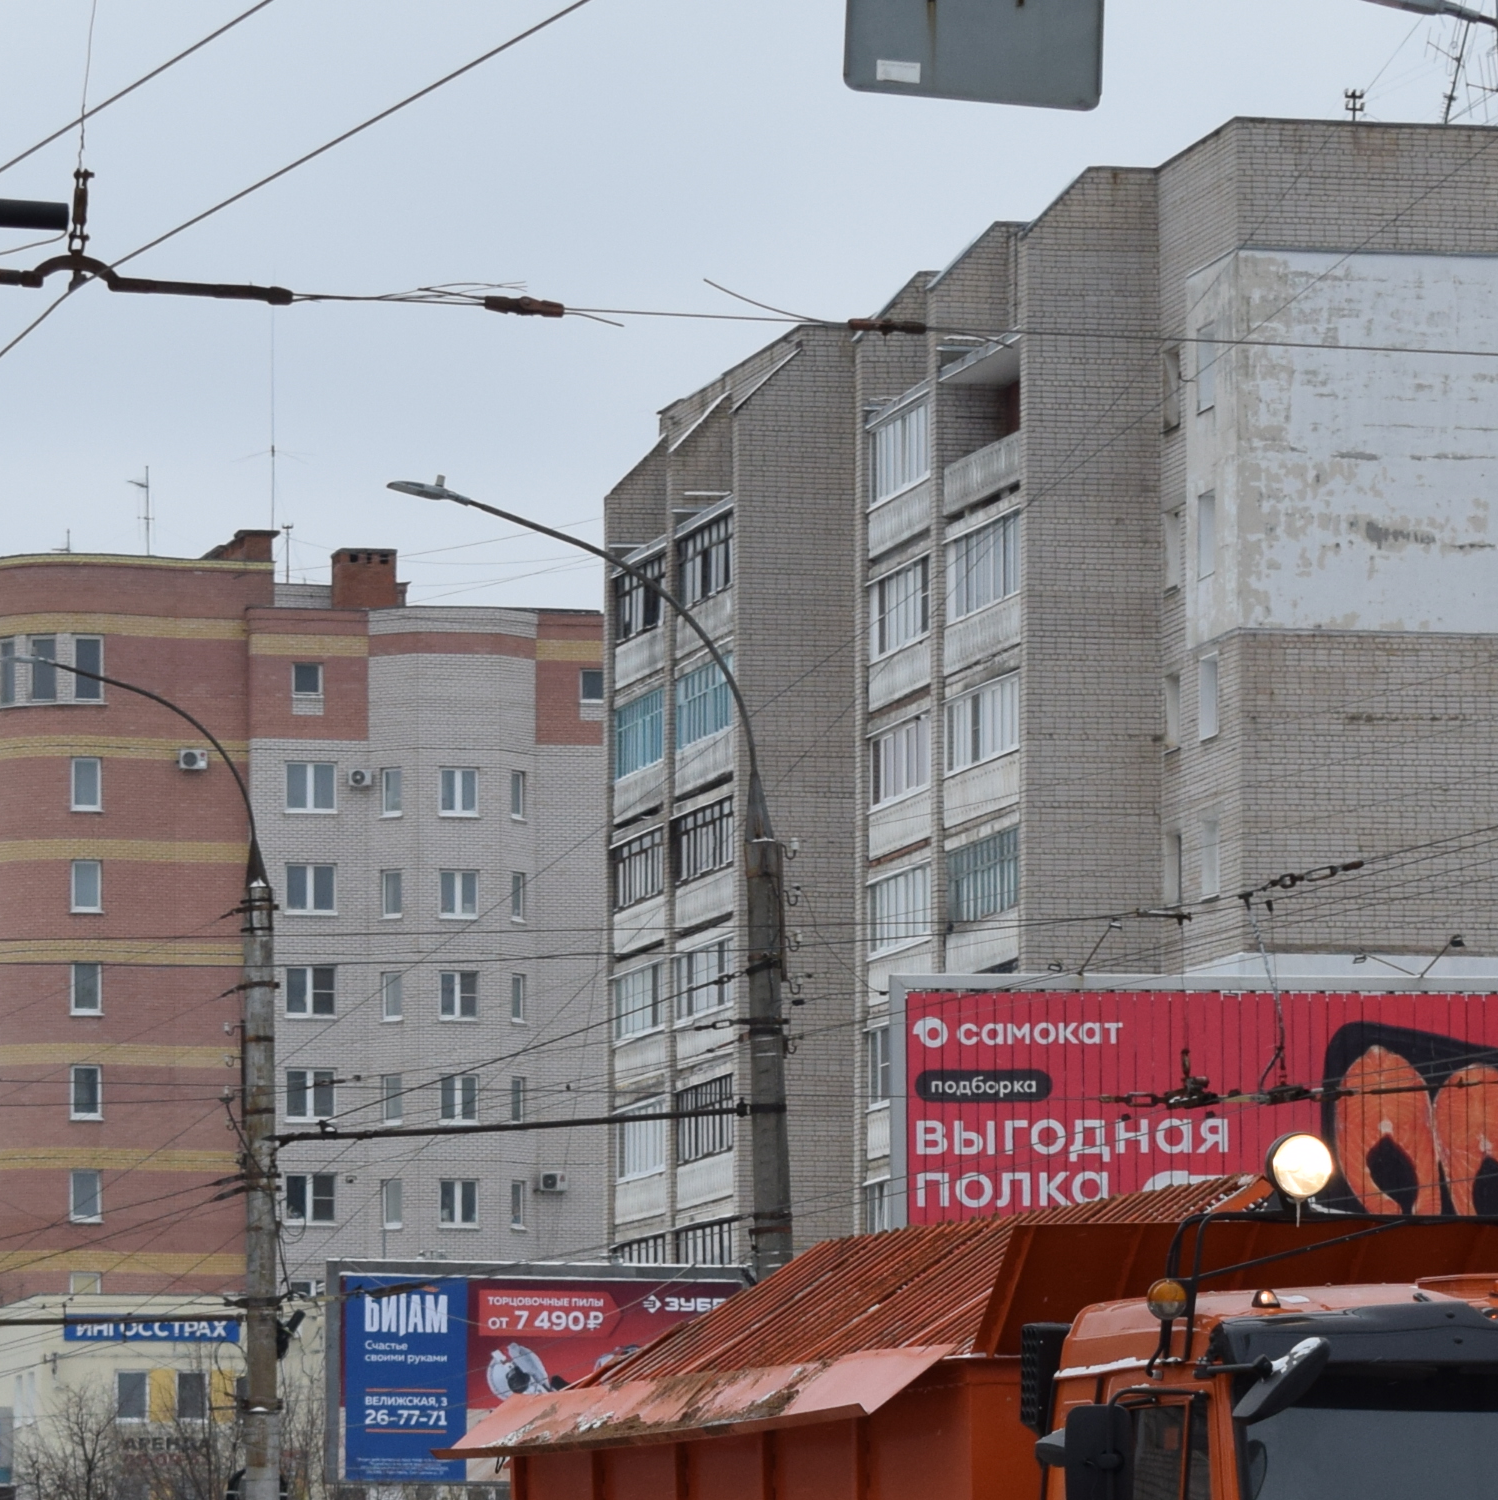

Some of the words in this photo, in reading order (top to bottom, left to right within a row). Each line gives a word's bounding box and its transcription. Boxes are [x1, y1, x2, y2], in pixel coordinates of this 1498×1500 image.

[956, 1021, 1124, 1046] самокат
[930, 1076, 1037, 1098] подборка
[487, 1296, 569, 1307] ТОРЦОВОЧНЫЕ
[571, 1297, 604, 1308] ПИЛЫ
[76, 1319, 227, 1337] ИНГОССТРАХ
[514, 1310, 529, 1330] 7
[364, 1340, 408, 1351] Счастье
[364, 1354, 405, 1363] своими
[407, 1354, 448, 1365] руками
[364, 1396, 439, 1408] ВЕЛИЖСКАЯ,
[440, 1397, 448, 1408] 3
[364, 1409, 448, 1426] 26-77-71
